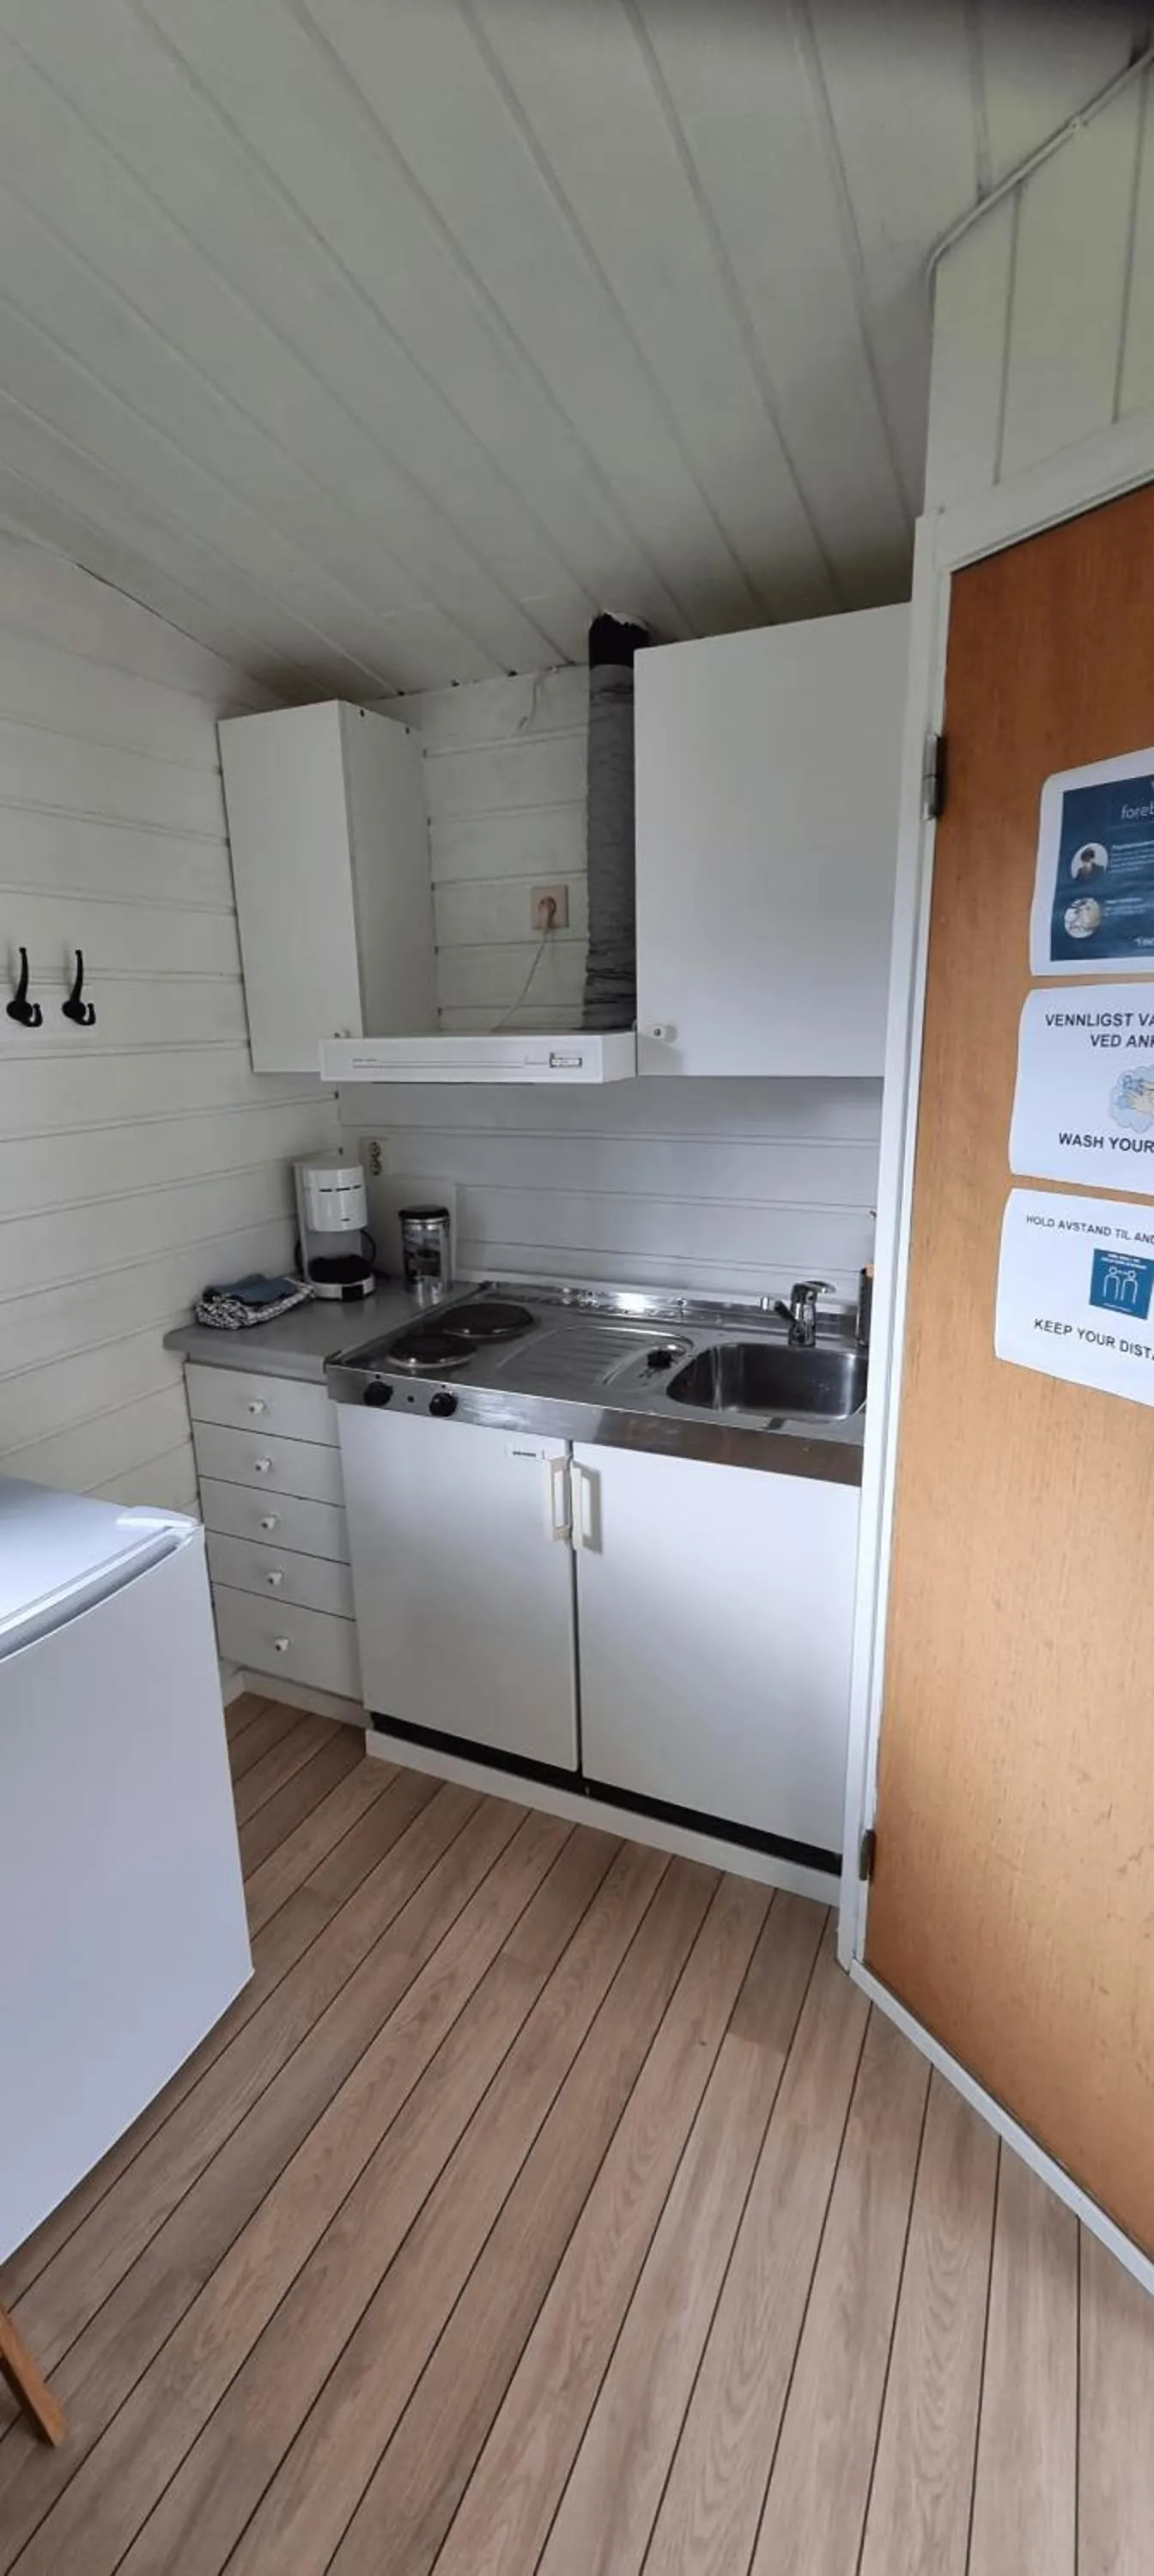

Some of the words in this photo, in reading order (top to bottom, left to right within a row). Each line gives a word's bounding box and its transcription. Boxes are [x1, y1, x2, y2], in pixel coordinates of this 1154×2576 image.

[1045, 1013, 1133, 1026] VENNLIGST
[1090, 1034, 1121, 1048] VED
[1059, 1133, 1103, 1147] WASH
[1108, 1137, 1154, 1153] YOUR
[1026, 1215, 1055, 1227] HOLD
[1058, 1219, 1111, 1236] AVSTAND
[1115, 1228, 1131, 1240] TIL
[1034, 1319, 1072, 1335] KEEP
[1077, 1328, 1115, 1349] YOUR
[1120, 1340, 1154, 1360] DIST
